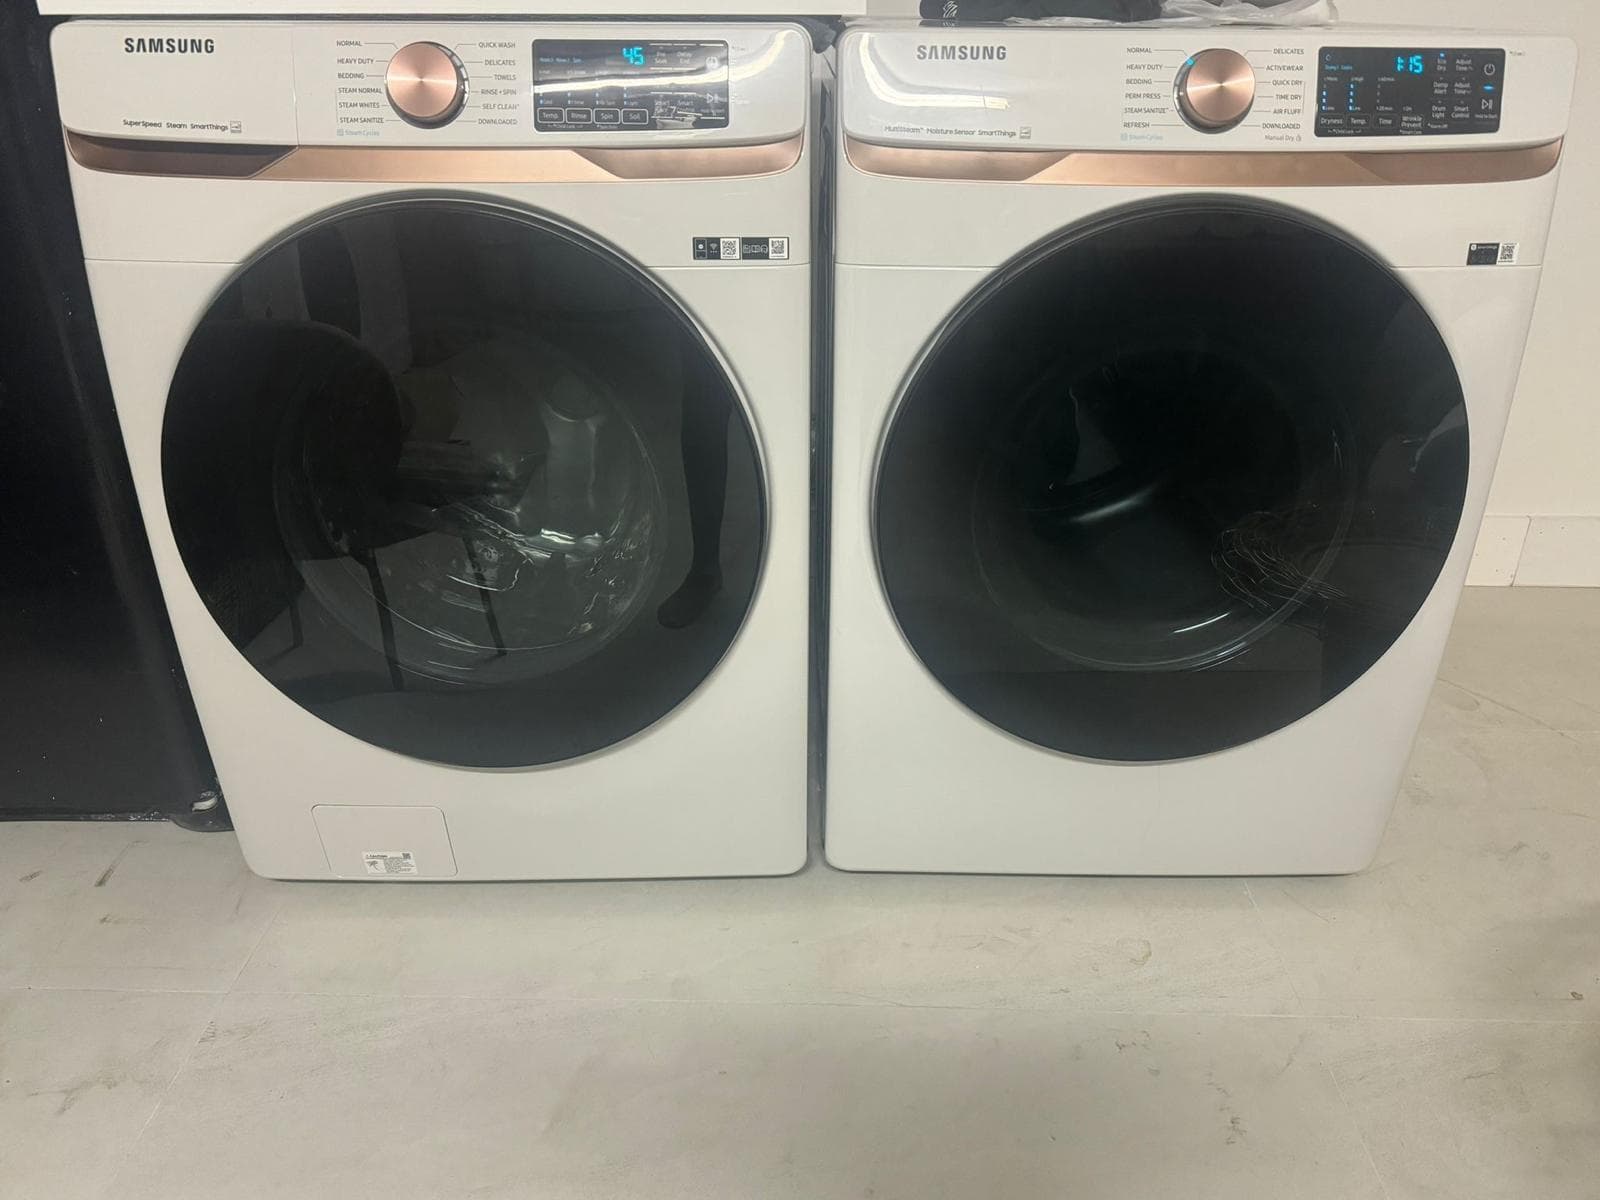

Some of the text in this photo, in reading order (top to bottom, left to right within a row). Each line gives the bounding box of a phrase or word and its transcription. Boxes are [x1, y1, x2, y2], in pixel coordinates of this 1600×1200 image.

[124, 38, 215, 53] SAMSUNG
[916, 45, 1007, 60] SAMSUNG
[622, 47, 644, 66] 45
[1396, 55, 1423, 74] 1:15
[600, 112, 614, 120] Spin
[123, 118, 229, 131] SuperSpeed Steam SmartThings
[978, 129, 1017, 138] SmartThings
